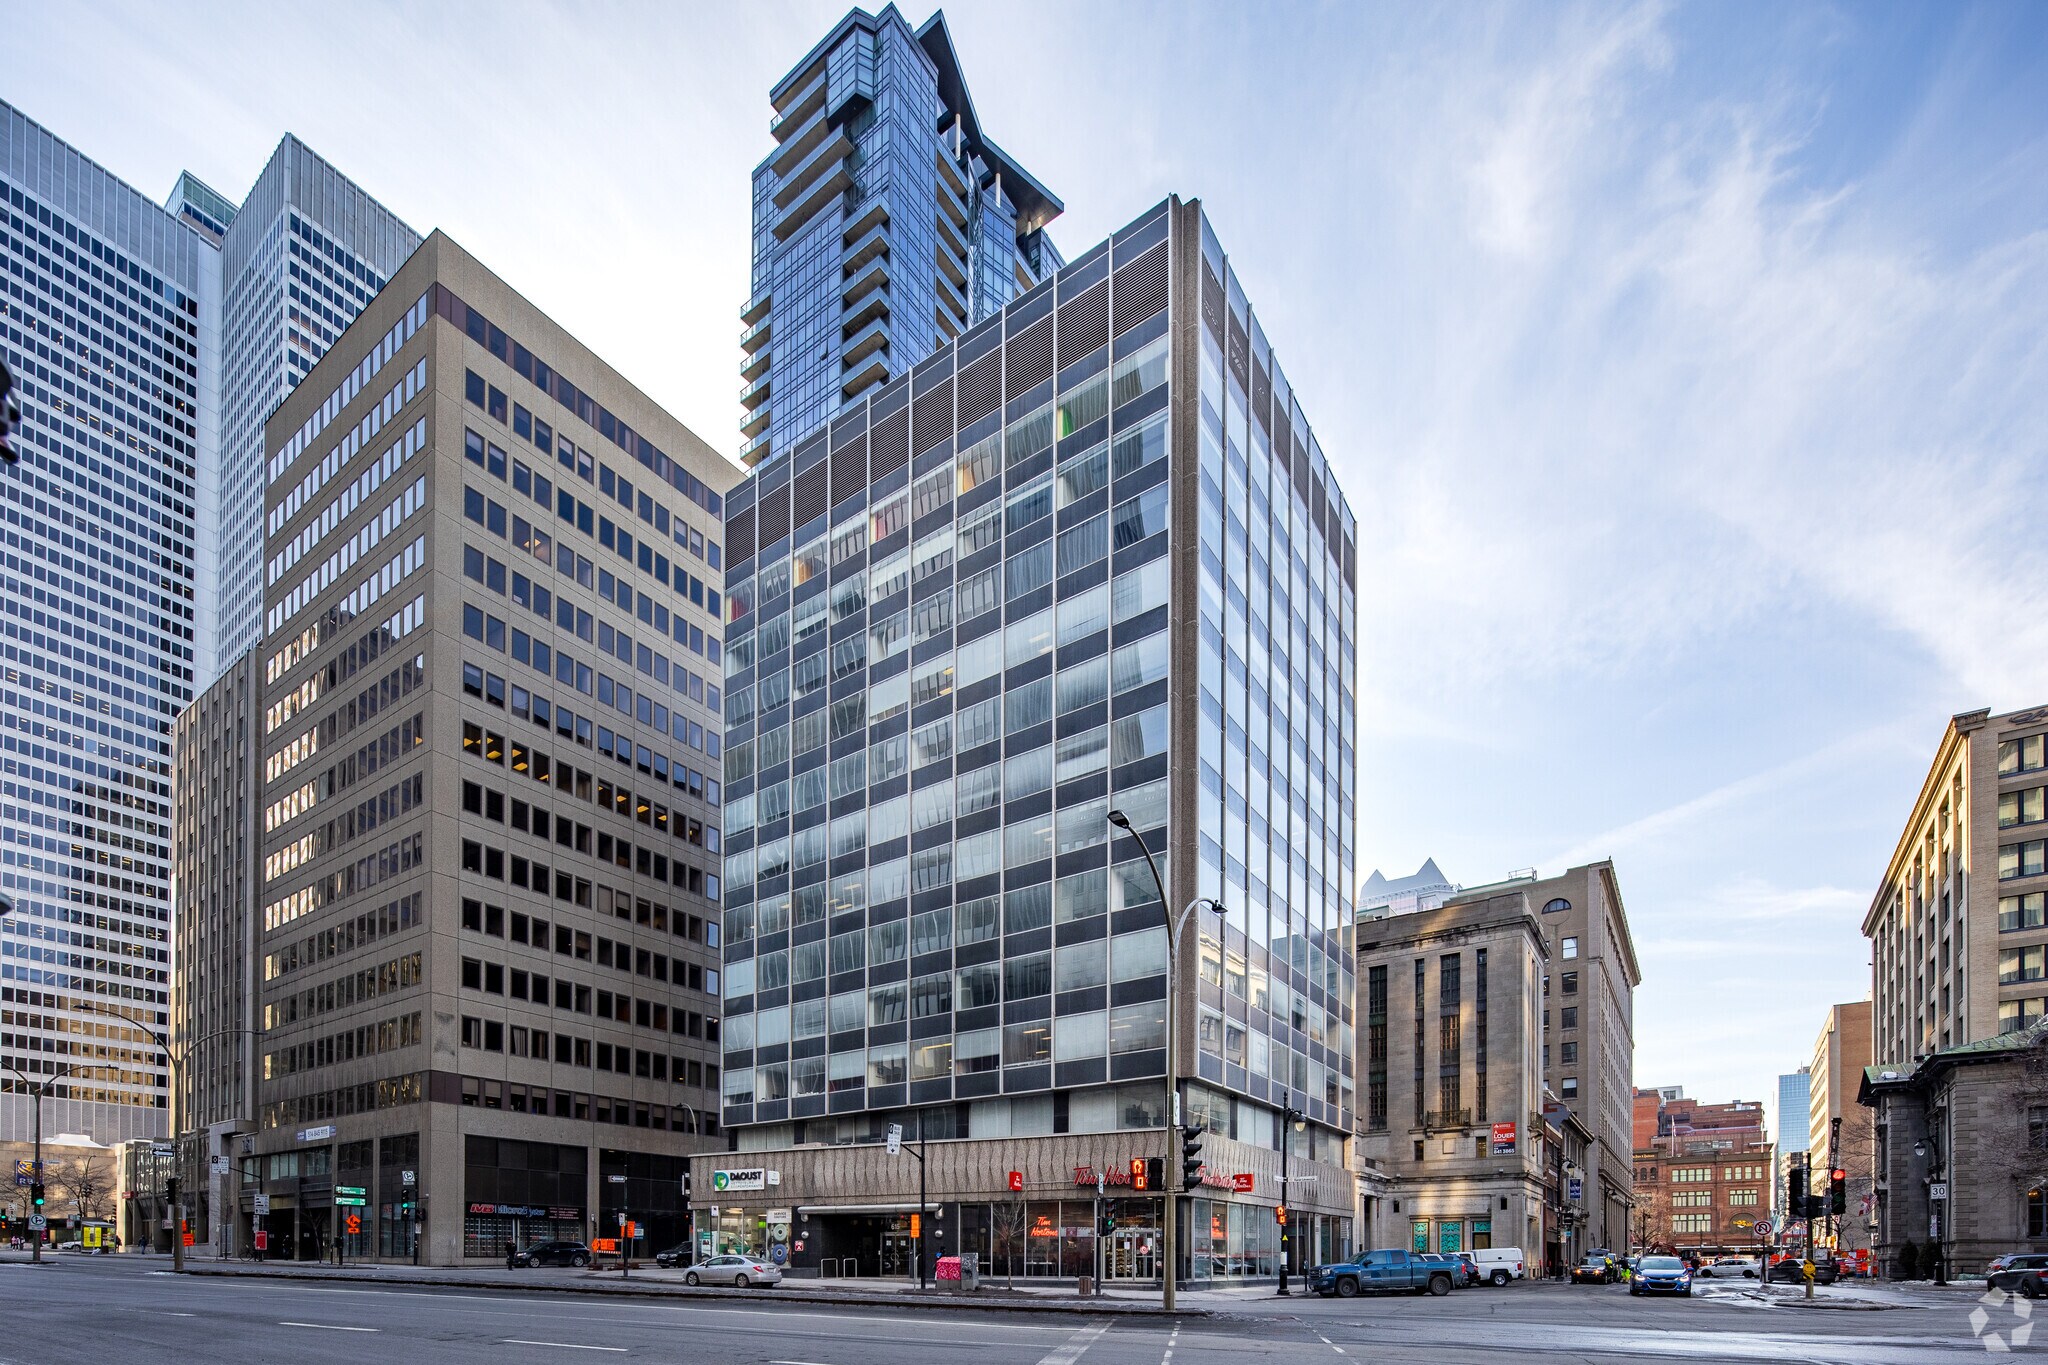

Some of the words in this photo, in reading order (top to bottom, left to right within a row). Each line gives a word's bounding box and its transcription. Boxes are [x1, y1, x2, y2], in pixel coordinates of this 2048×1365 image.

[729, 1171, 762, 1181] DAOUST
[1073, 1166, 1099, 1185] Tim
[1932, 1187, 1945, 1196] 30
[1037, 1216, 1051, 1226] Tim
[1030, 1226, 1058, 1237] Hortons
